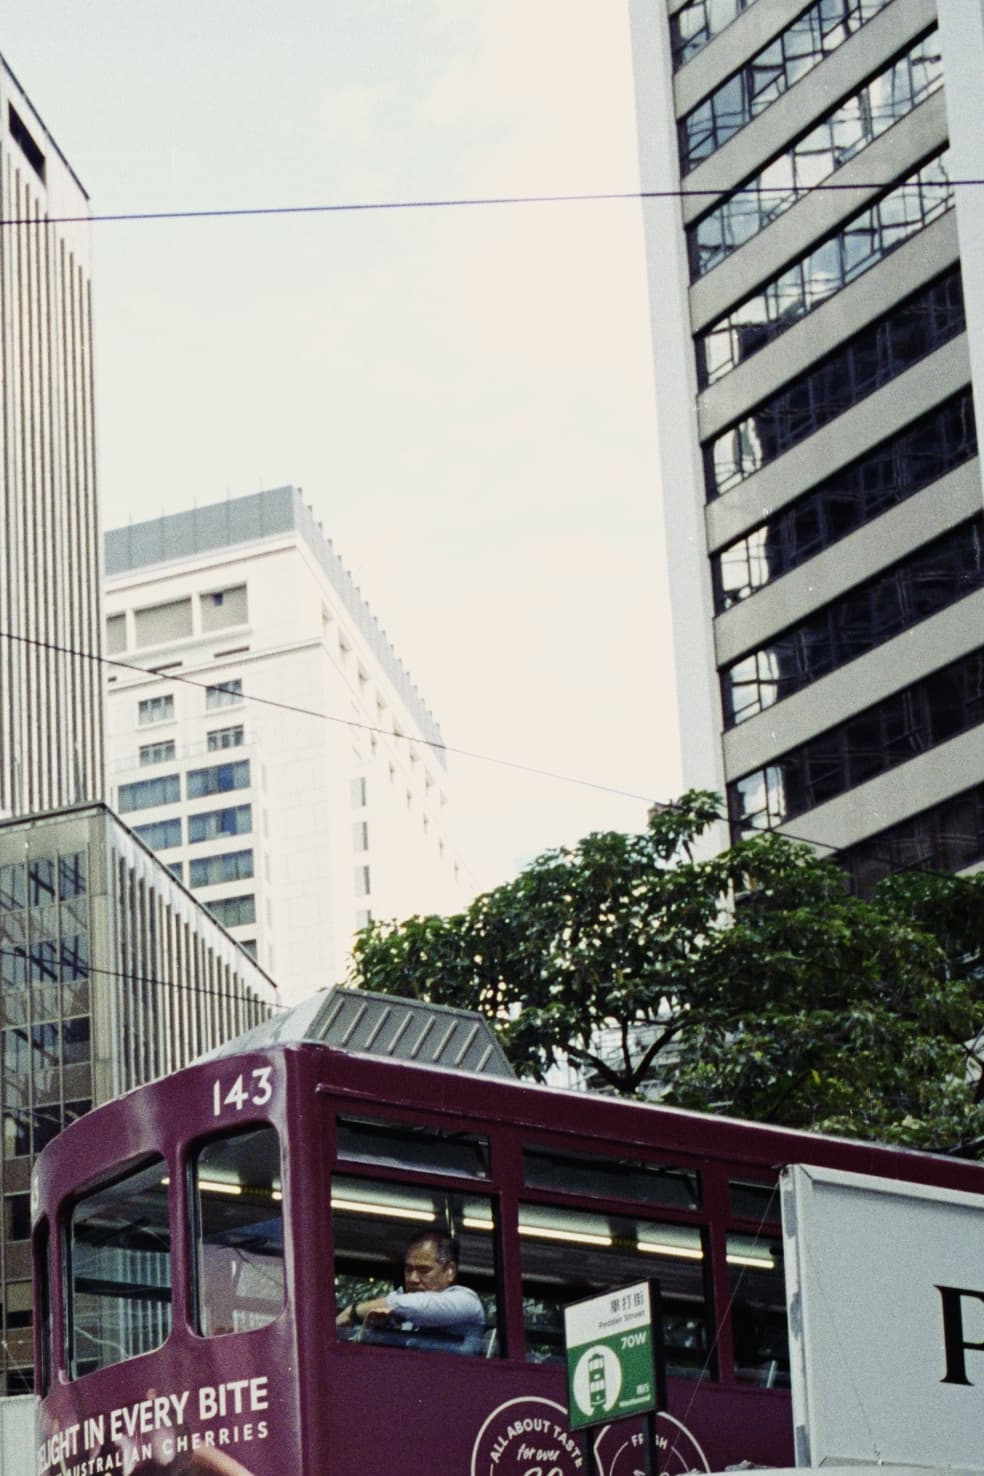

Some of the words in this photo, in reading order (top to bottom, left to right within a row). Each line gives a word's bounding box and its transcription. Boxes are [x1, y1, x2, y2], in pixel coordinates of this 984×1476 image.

[213, 1066, 272, 1116] 143
[624, 1309, 645, 1321] Street
[621, 1331, 647, 1350] 70W
[84, 1414, 104, 1450] IN
[110, 1391, 189, 1442] EVERY
[199, 1376, 269, 1420] BITE
[162, 1421, 269, 1455] CHERRIES
[490, 1436, 509, 1464] ALL
[507, 1418, 551, 1440] ABOUT
[553, 1425, 583, 1469] TASTE
[517, 1443, 536, 1461] for
[536, 1449, 560, 1461] over
